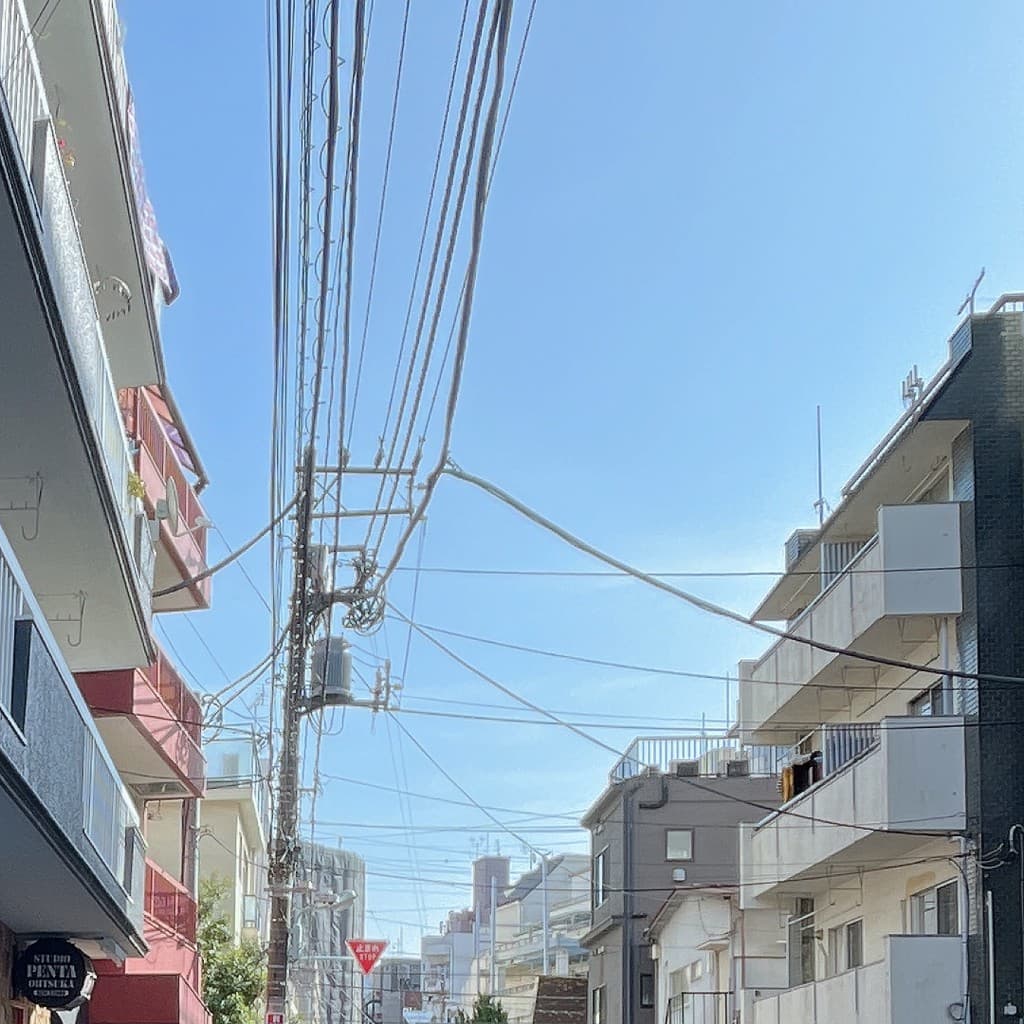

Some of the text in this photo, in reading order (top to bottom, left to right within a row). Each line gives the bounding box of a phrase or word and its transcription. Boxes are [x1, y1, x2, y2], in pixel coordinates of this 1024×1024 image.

[33, 954, 71, 963] STUDIO
[27, 964, 77, 978] PENTA
[28, 980, 75, 988] OHTSUKA
